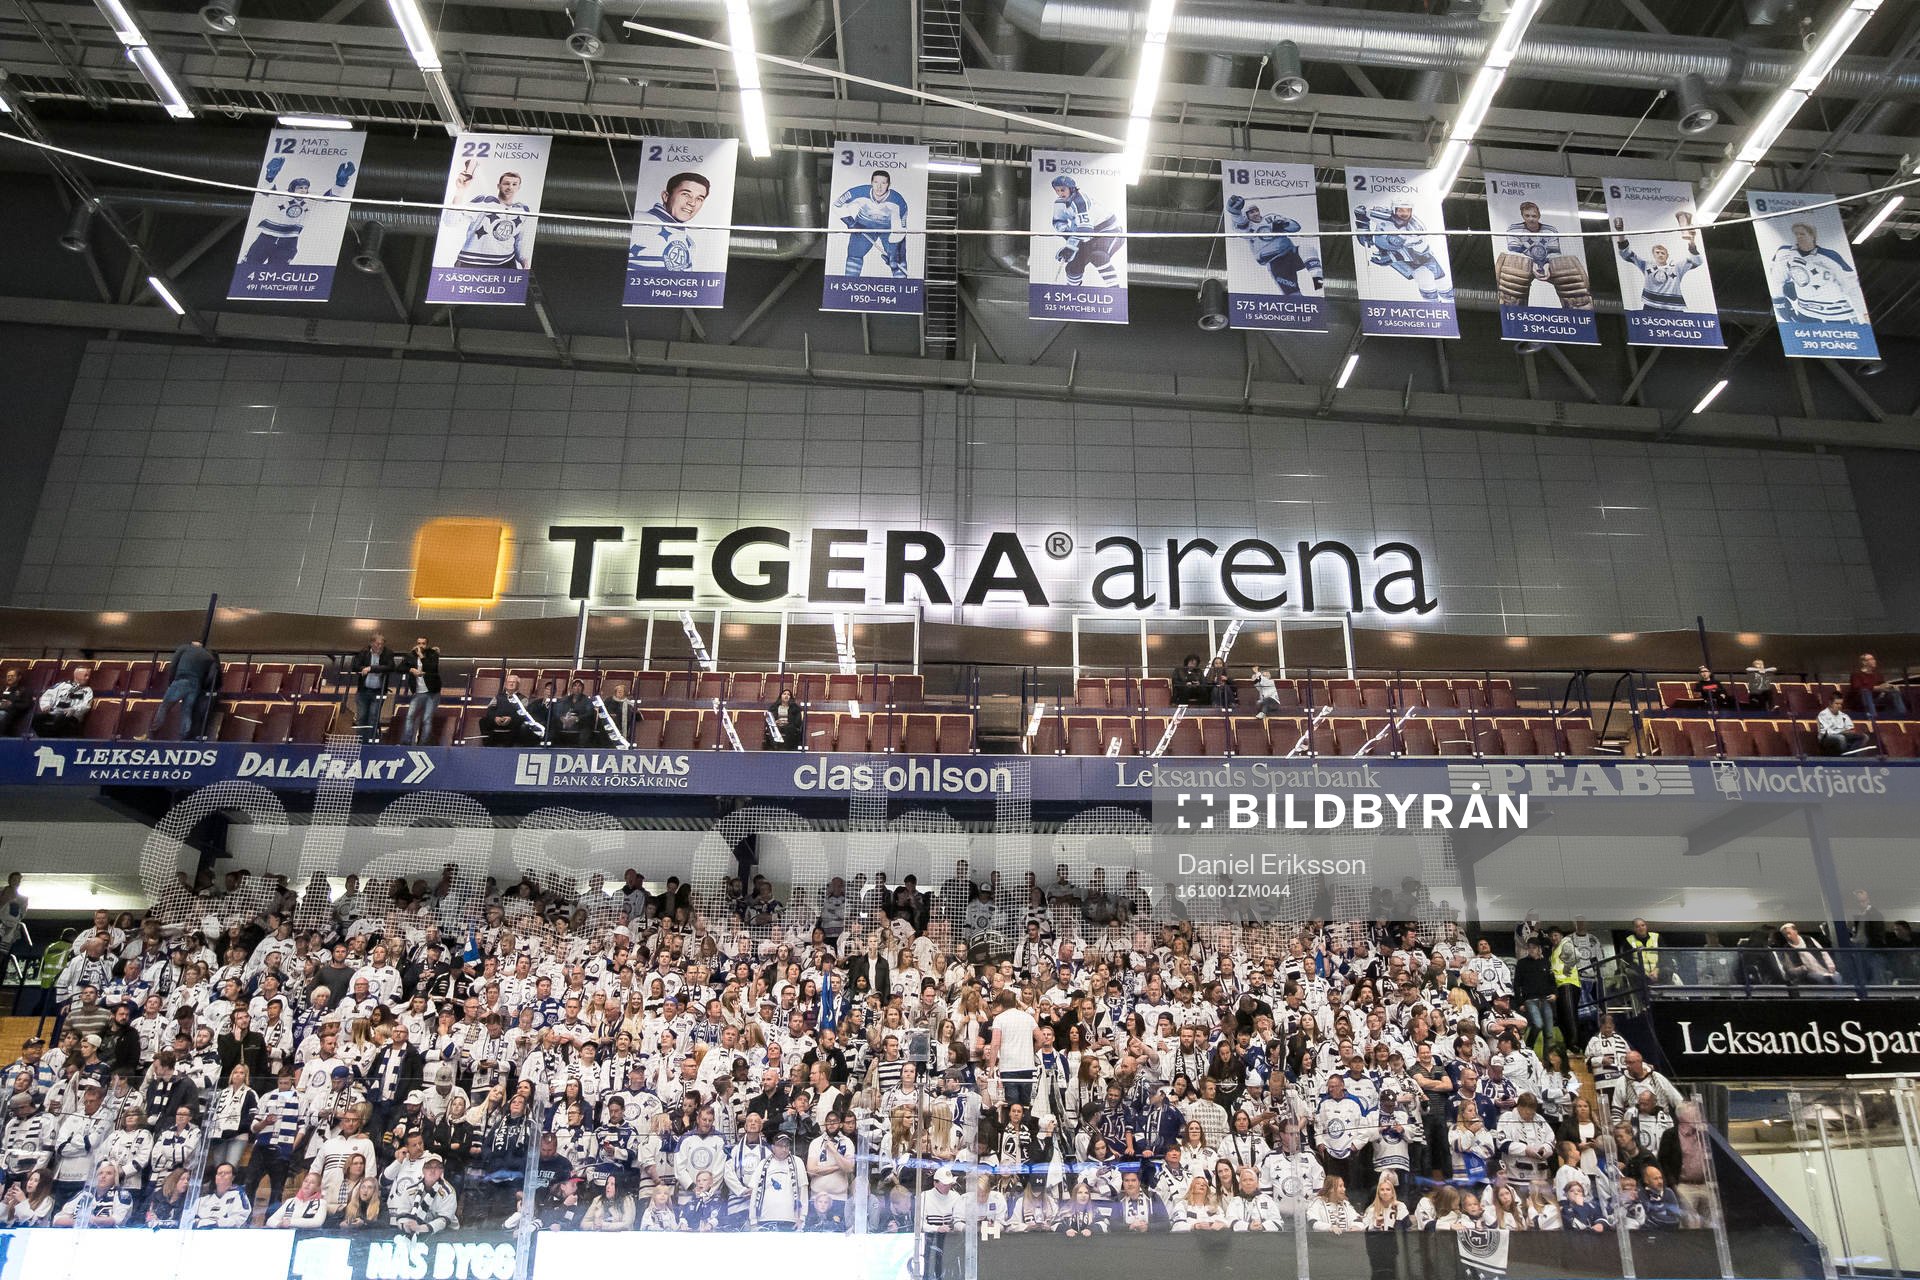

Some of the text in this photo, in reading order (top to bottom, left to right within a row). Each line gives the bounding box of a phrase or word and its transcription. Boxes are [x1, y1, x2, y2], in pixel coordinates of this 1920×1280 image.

[274, 138, 297, 154] 12
[302, 138, 329, 146] MATS
[495, 142, 524, 150] NISSE
[299, 146, 348, 156] ÅHLBERG
[462, 142, 491, 158] 22
[648, 145, 663, 162] 2
[668, 144, 689, 154] ÅKE
[859, 150, 898, 160] VILGOT
[493, 151, 539, 160] NILSSON
[666, 155, 703, 163] LASSAS
[841, 150, 854, 166] 3
[859, 159, 908, 169] LARSSON
[1038, 158, 1057, 173] 15
[1060, 159, 1082, 167] DAN
[1228, 168, 1250, 185] 18
[1254, 169, 1287, 178] JONAS
[1369, 175, 1406, 184] TOMAS
[1254, 178, 1309, 189] BERGQVIST
[1353, 175, 1367, 191] 2
[1370, 184, 1418, 194] JONSSON
[1491, 180, 1498, 194] 1
[1500, 180, 1541, 189] CHRISTER
[1501, 188, 1525, 196] ABRIS
[1609, 185, 1621, 199] 6
[1755, 198, 1768, 212] 8
[1079, 213, 1090, 223] 15
[248, 271, 319, 282] 4 SM-GULD
[438, 273, 444, 281] 7
[445, 272, 500, 283] SÄSONGER
[508, 275, 523, 284] LIF
[630, 277, 641, 286] 23
[643, 276, 699, 287] SÄSONGER
[707, 279, 721, 288] LIF
[260, 284, 298, 292] MATCHER
[458, 285, 506, 294] SM-GULD
[830, 282, 839, 290] 14
[841, 281, 897, 293] SÄSONGER
[905, 286, 919, 294] LIF
[1043, 292, 1114, 305] 4 SM-GULD
[1044, 303, 1057, 311] 525
[1060, 305, 1097, 313] MATCHER
[1236, 300, 1319, 313] 575 MATCHER
[1367, 307, 1451, 320] 387 MATCHER
[1506, 312, 1516, 320] 15
[1517, 311, 1571, 324] SÄSONGER
[1578, 316, 1592, 325] LIF
[1384, 319, 1425, 328] SÄSONGER
[1631, 317, 1640, 326] 13
[1642, 316, 1696, 328] SÄSONGER
[1702, 320, 1716, 329] LIF
[1523, 324, 1577, 335] 3 SM-GULD
[1648, 329, 1702, 339] 3 SM-GULD
[1812, 330, 1860, 339] MATCHER
[1092, 537, 1438, 615] arena
[73, 748, 218, 766] LEKSANDS
[554, 754, 690, 776] DALARNAS
[89, 769, 192, 780] KNÄCKEBRÖD
[793, 757, 1012, 793] clas ohlson
[1115, 762, 1381, 794] Leksands Sparbank
[1485, 764, 1663, 796] PEAB
[552, 774, 688, 788] BANK & FÖRSÄKRING
[1677, 1020, 1920, 1064] Leksands Spar
[433, 1242, 517, 1280] BYGG
